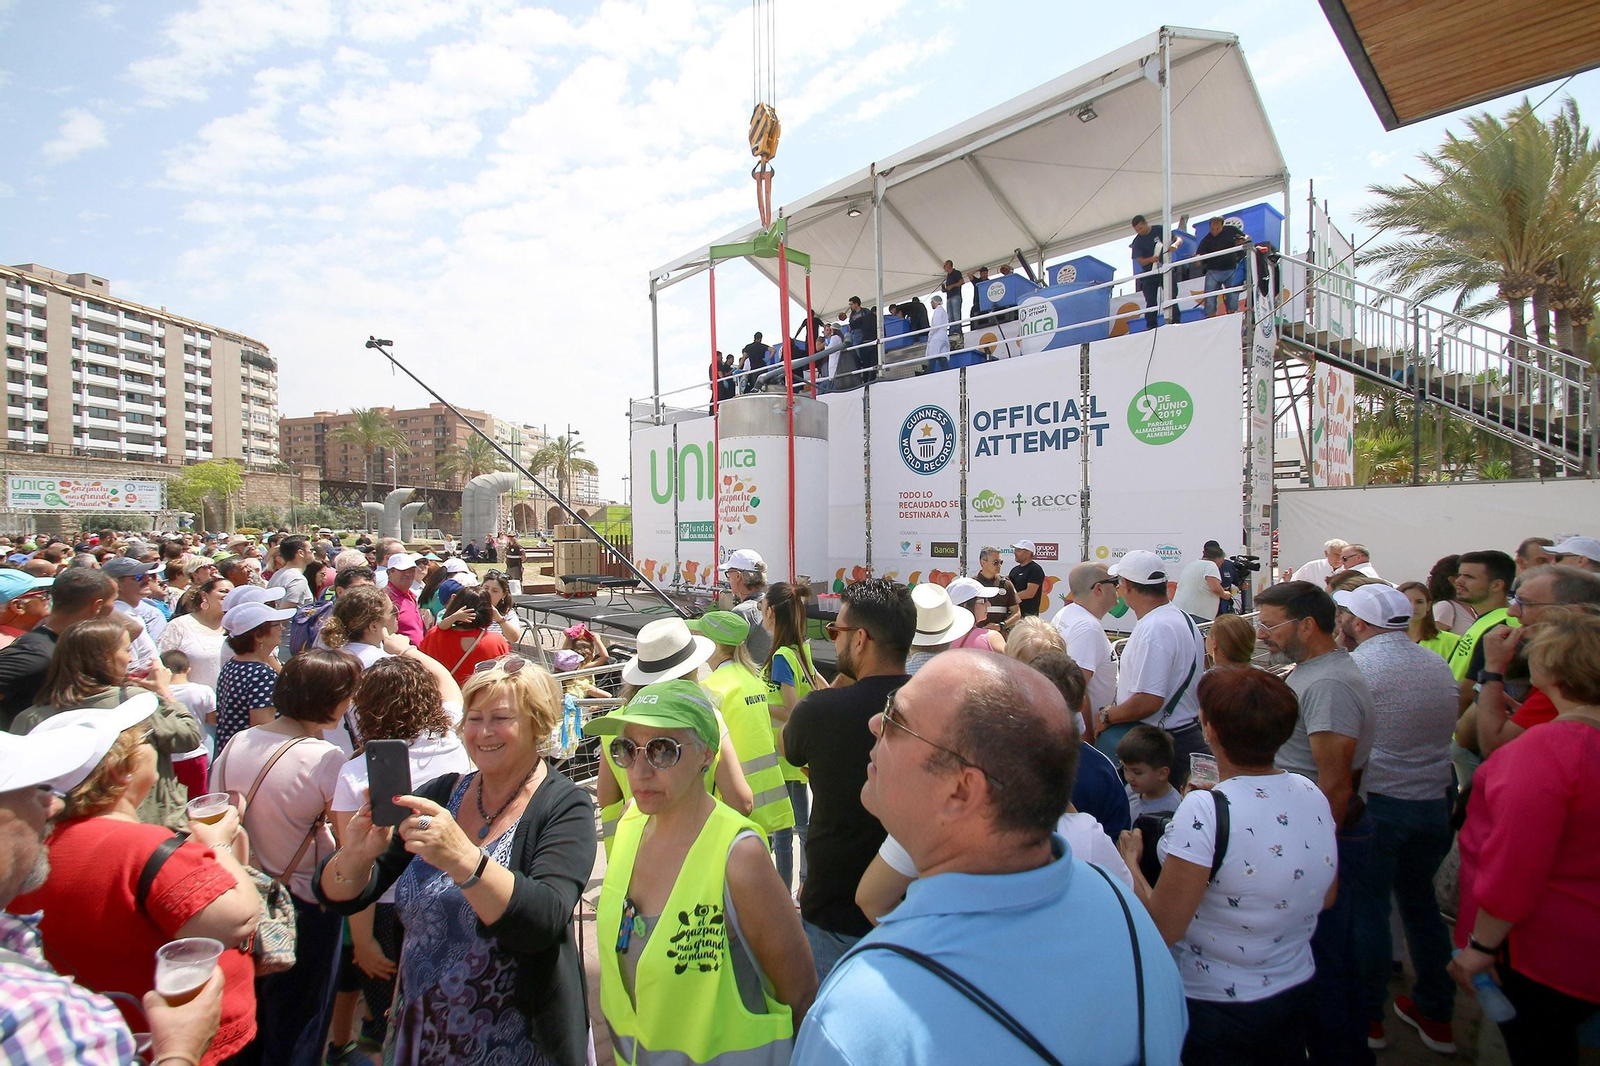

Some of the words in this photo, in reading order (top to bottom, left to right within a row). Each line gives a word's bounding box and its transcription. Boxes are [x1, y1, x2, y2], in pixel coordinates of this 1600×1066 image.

[1021, 316, 1054, 336] nica
[973, 396, 1106, 432] OFFICIAL
[1136, 394, 1157, 422] 9
[1158, 401, 1188, 410] JUNIO
[1158, 409, 1182, 419] 2019
[906, 410, 948, 430] GUINNESS
[1134, 424, 1187, 434] ALMADRABILLAS
[975, 423, 1110, 457] ATTEMPT
[902, 438, 920, 468] WORLD
[924, 434, 952, 471] RECORDS
[1032, 494, 1077, 506] aecc
[690, 524, 714, 532] fundaci
[686, 925, 725, 942] gazpach
[694, 938, 724, 952] grand
